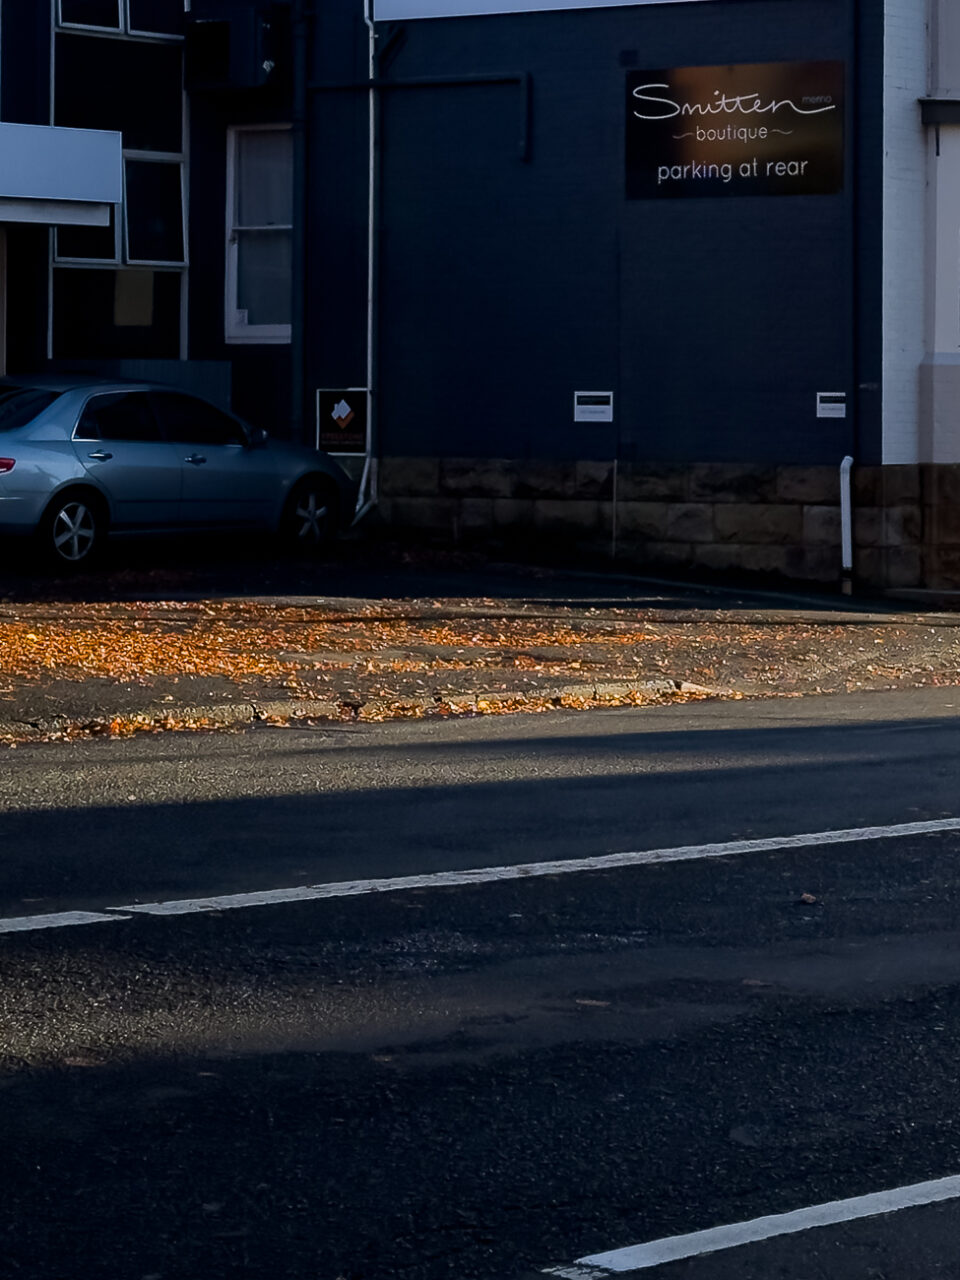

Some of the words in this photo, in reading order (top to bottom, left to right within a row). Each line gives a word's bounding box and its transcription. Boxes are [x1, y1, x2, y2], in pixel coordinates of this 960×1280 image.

[632, 83, 836, 120] Smitten
[696, 125, 768, 143] boutique
[657, 160, 731, 184] parking
[739, 157, 758, 177] at
[766, 159, 809, 177] rear
